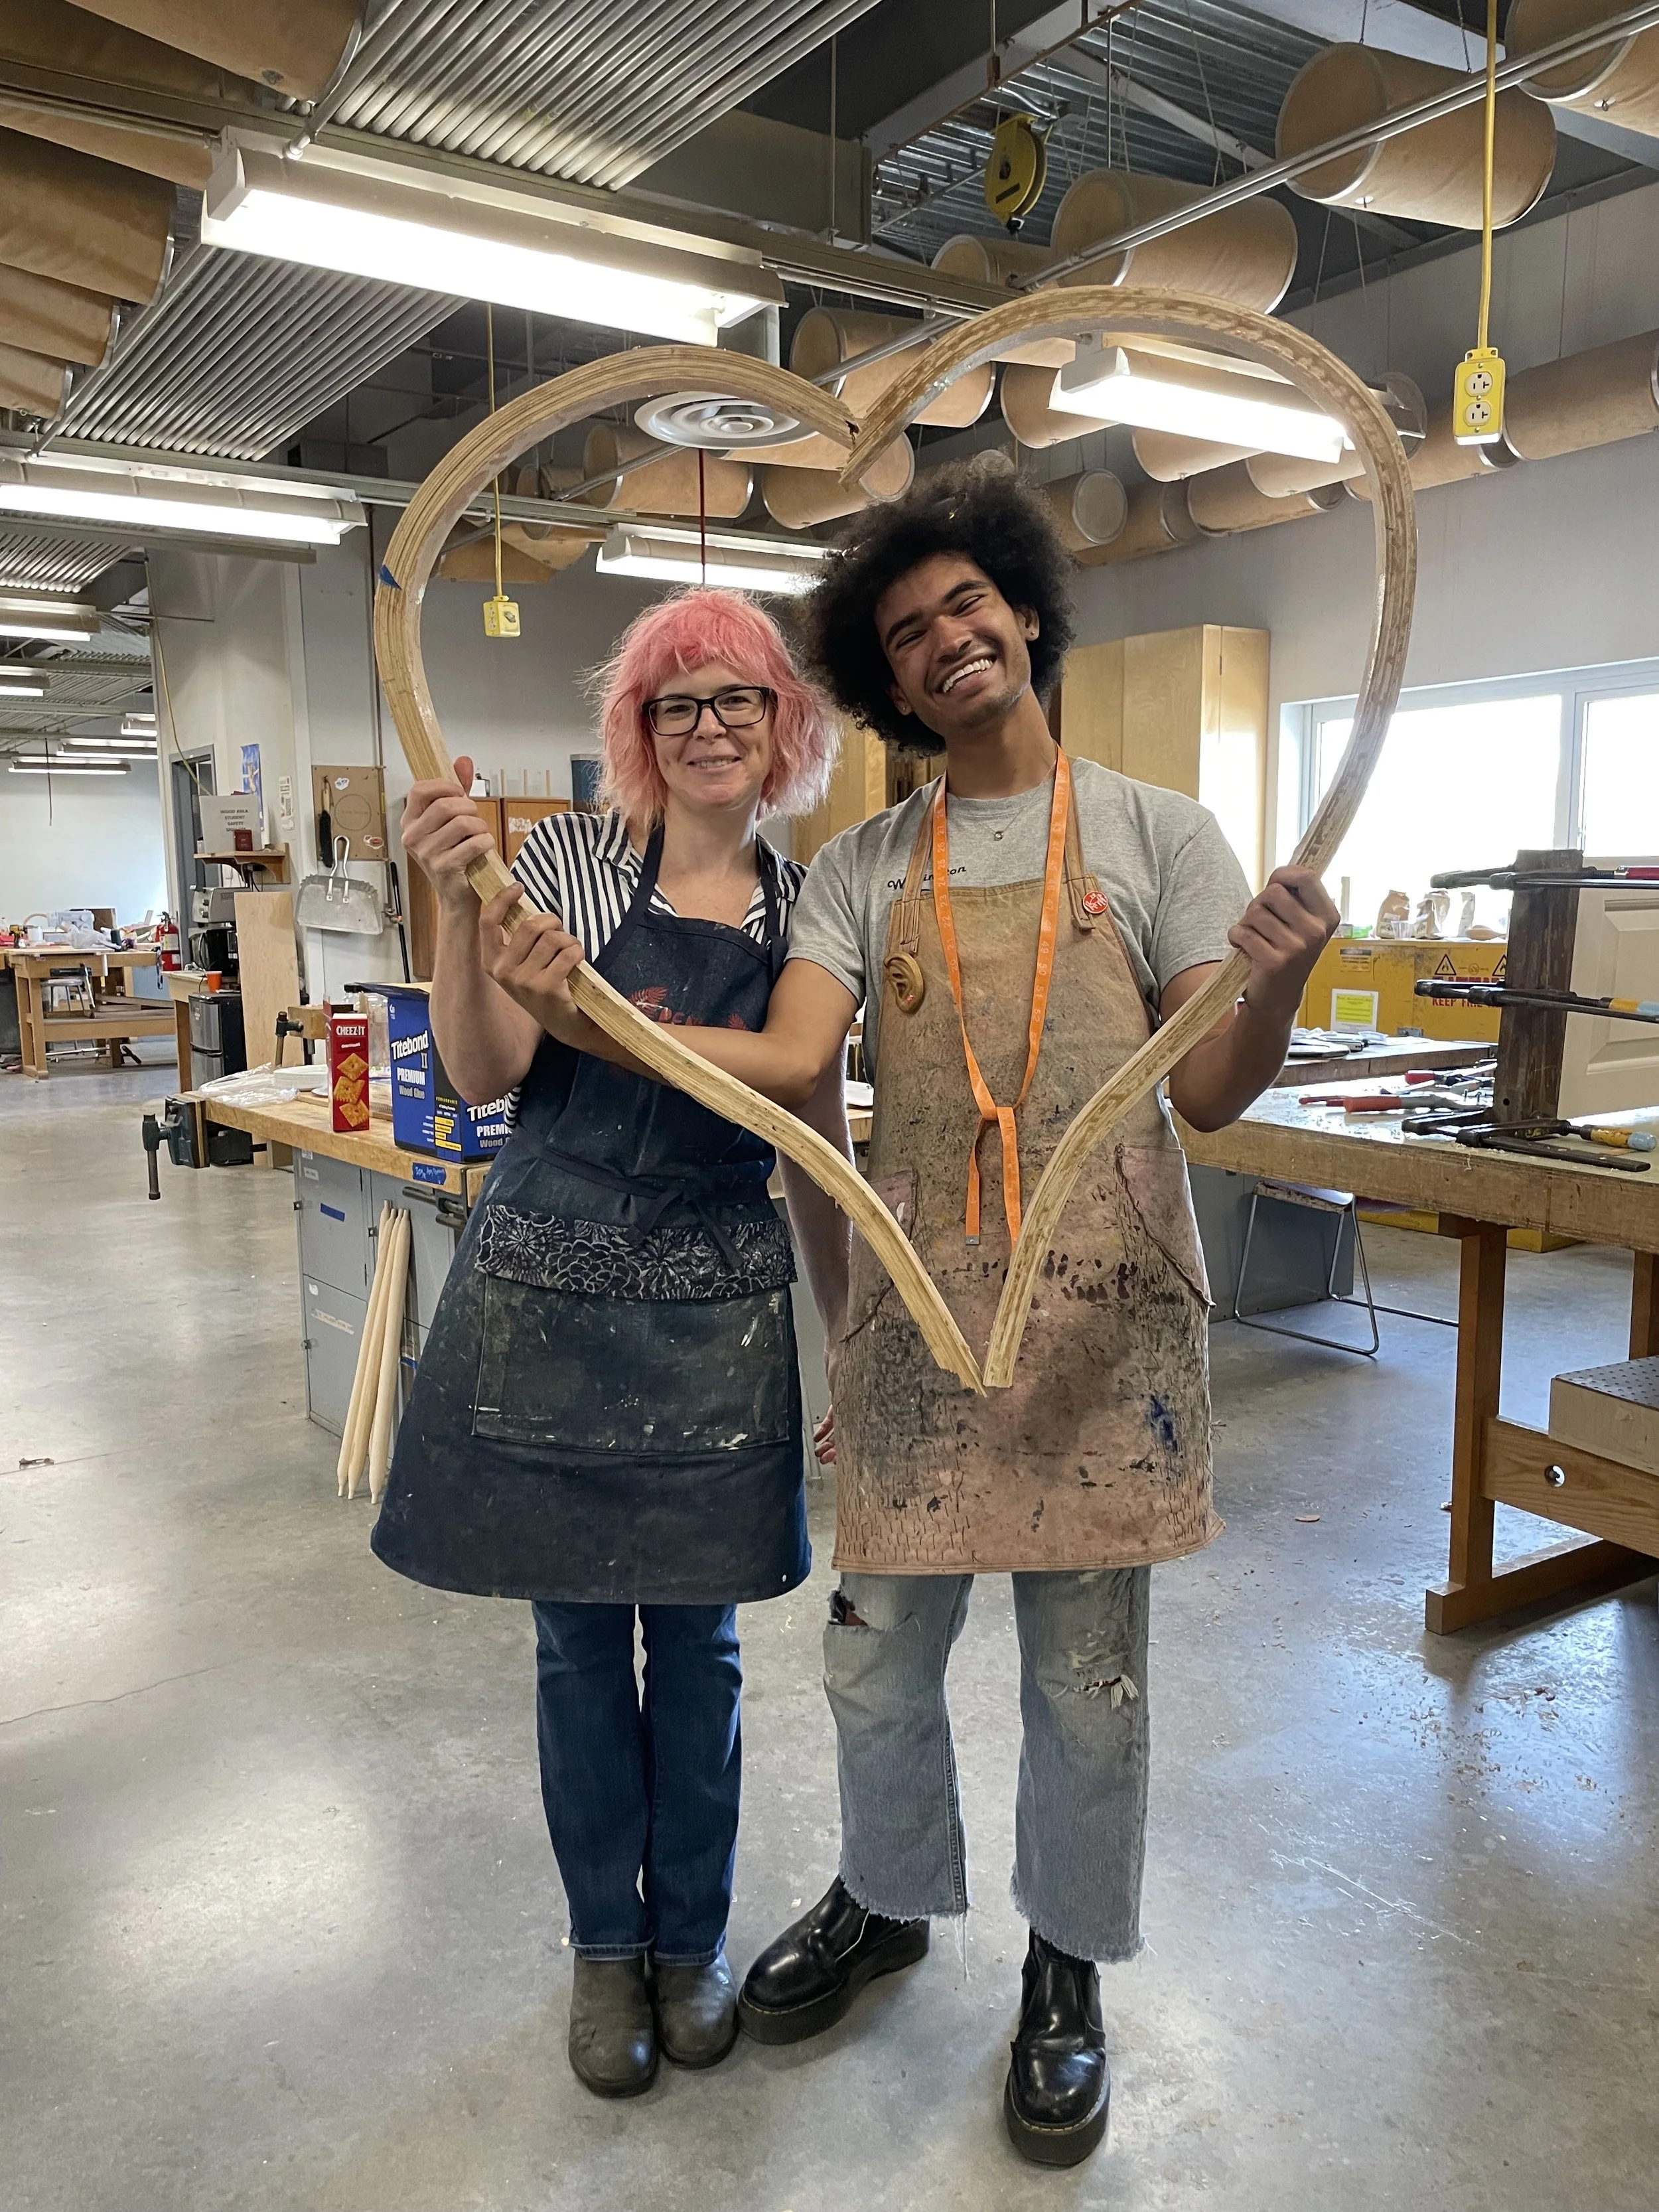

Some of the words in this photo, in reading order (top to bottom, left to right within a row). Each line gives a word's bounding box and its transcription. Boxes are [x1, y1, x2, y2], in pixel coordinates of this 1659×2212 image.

[938, 875, 946, 888] 24
[939, 894, 948, 908] 23
[1038, 962, 1047, 976] 50
[1035, 985, 1045, 999] 51
[1432, 997, 1457, 1007] KEEP
[390, 1029, 429, 1061] Titebond
[420, 1052, 428, 1069] II
[396, 1067, 426, 1086] PREMIUM
[467, 1098, 505, 1122] Titeb
[476, 1123, 508, 1138] PREMI
[479, 1138, 503, 1148] Wood
